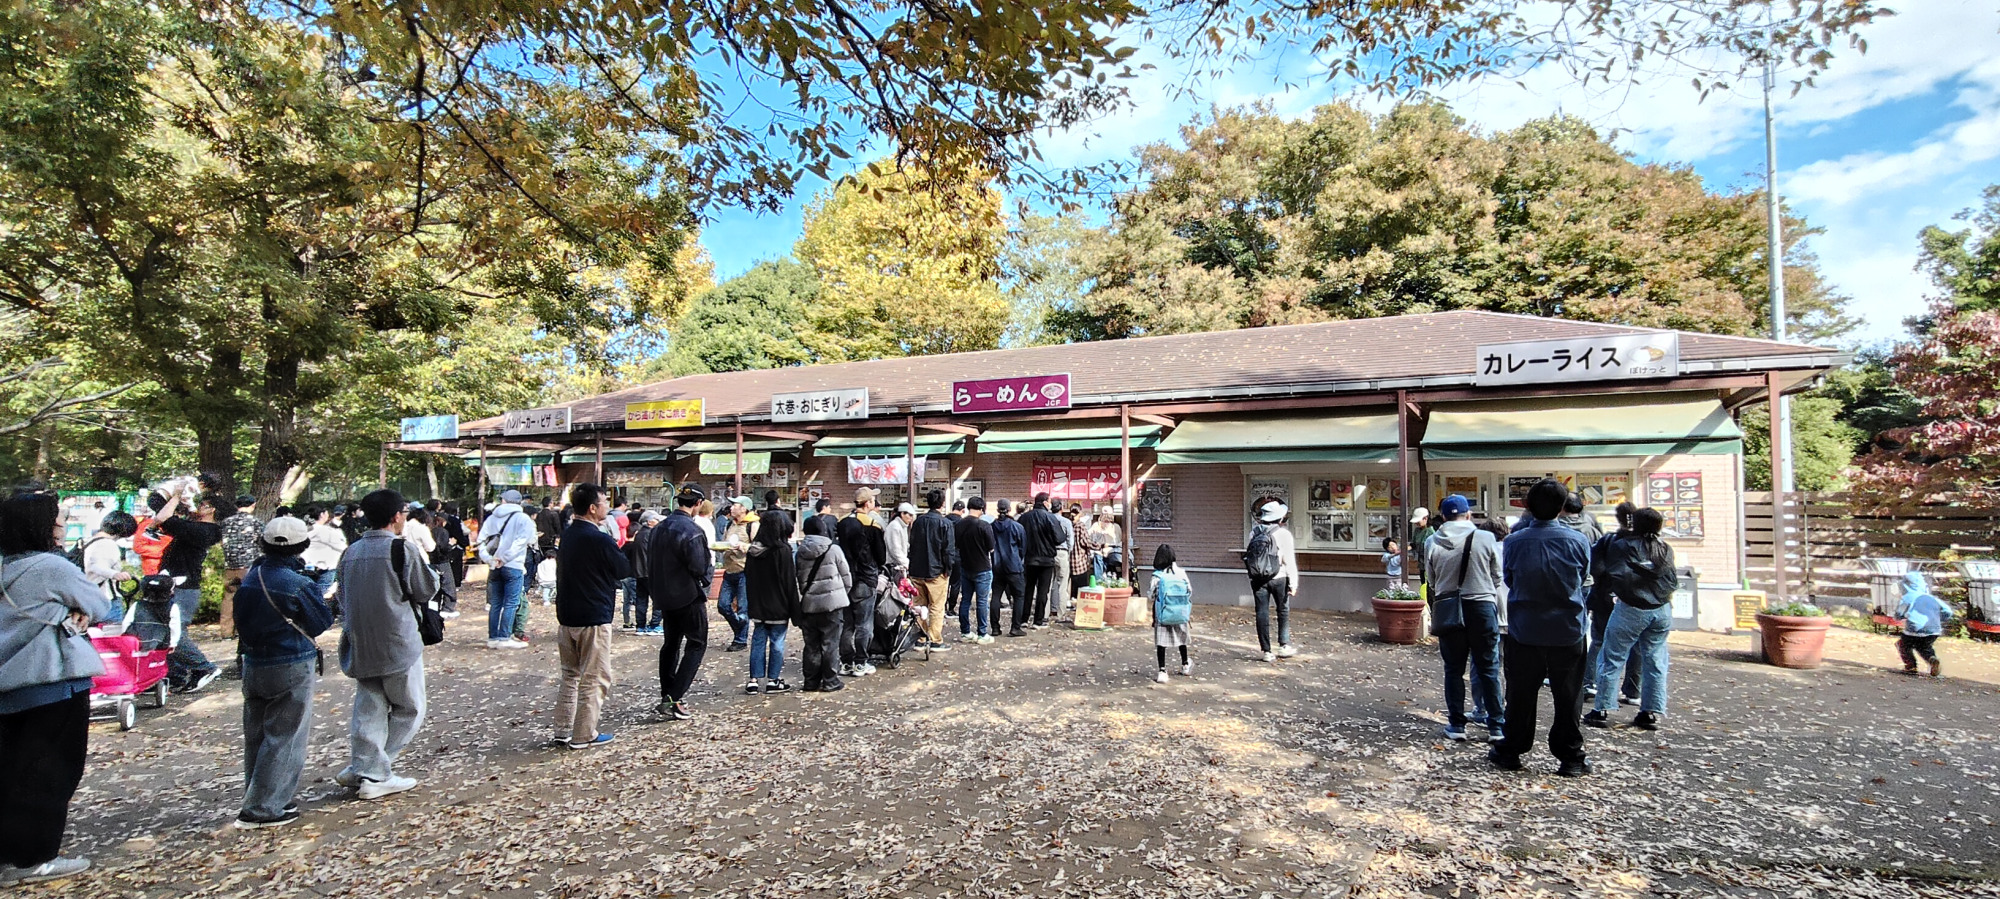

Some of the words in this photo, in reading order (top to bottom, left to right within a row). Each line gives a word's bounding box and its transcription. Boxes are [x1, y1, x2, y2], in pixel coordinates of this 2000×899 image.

[1483, 347, 1621, 375] カレーライス
[956, 383, 1038, 406] らーめん
[627, 408, 687, 421] から揚げ・たこ焼き
[775, 396, 841, 415] 太巻・おにぎり
[853, 462, 897, 481] かき氷
[1052, 471, 1122, 491] ラーメン
